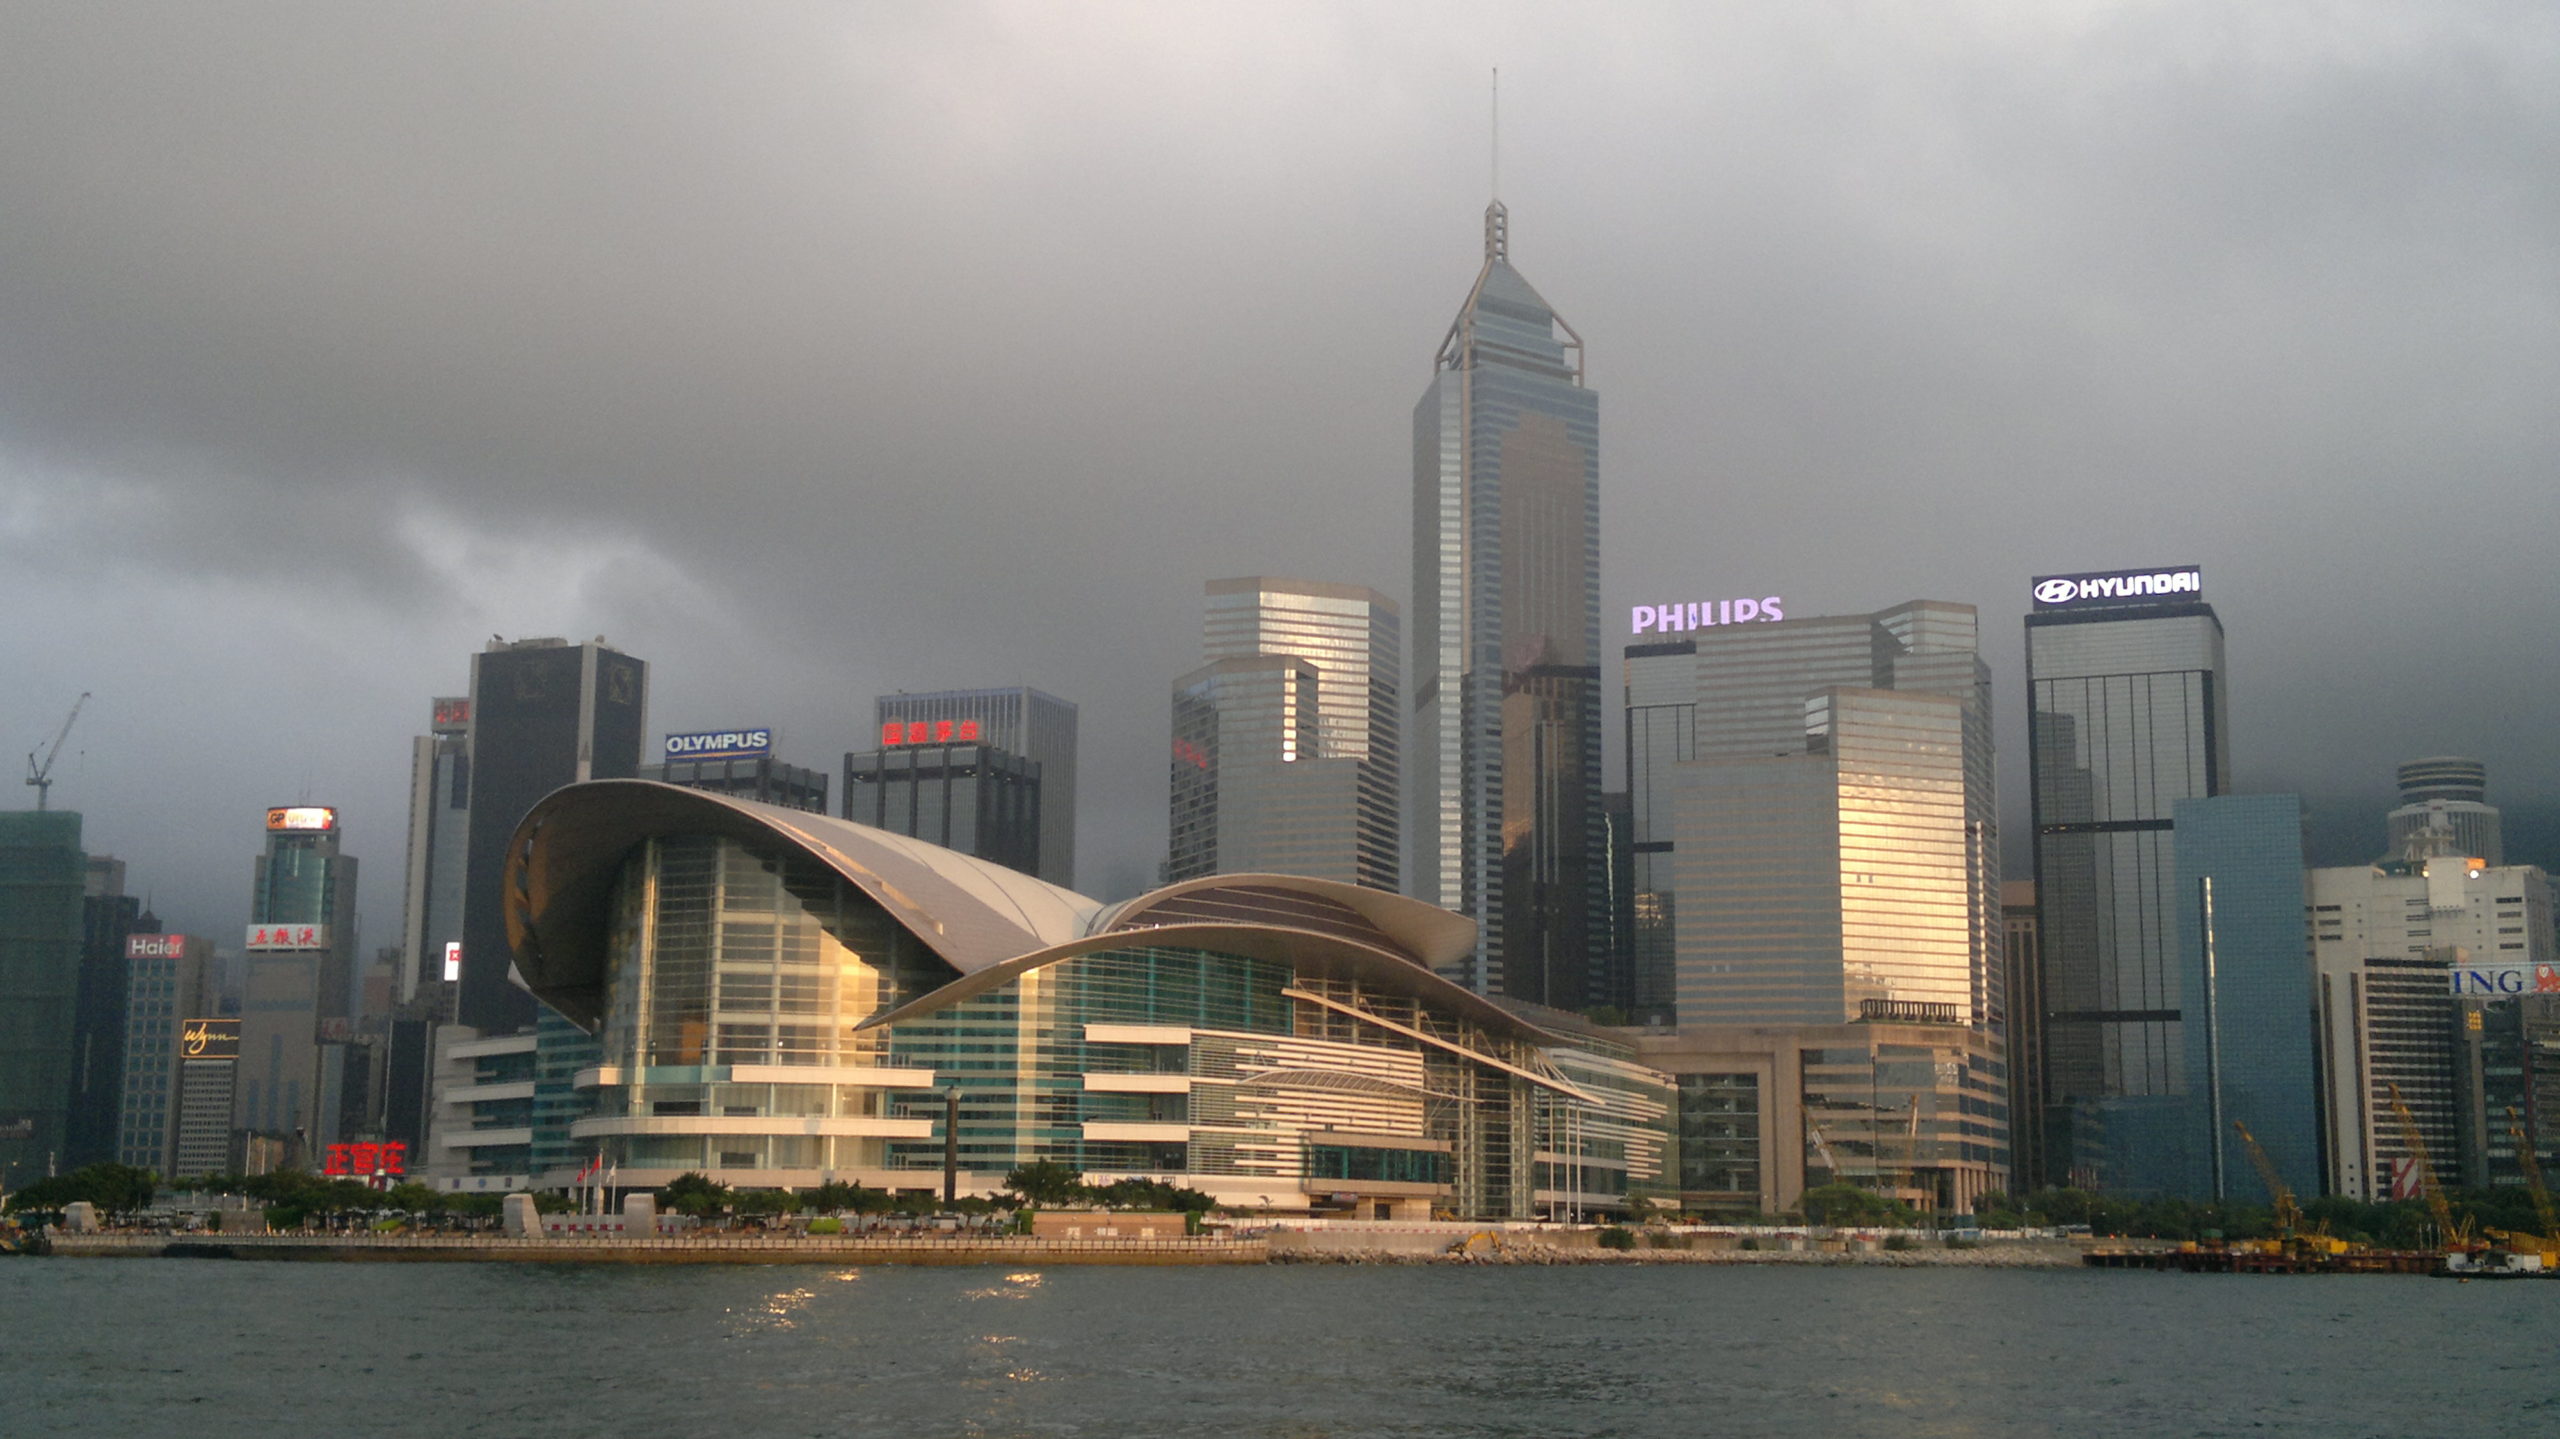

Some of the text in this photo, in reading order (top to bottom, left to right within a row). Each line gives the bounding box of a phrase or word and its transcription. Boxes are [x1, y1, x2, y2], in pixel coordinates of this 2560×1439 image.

[2079, 572, 2199, 599] HYUNDAI
[1631, 597, 1784, 634] PHILIPS
[666, 732, 768, 752] OLYMPUS
[132, 938, 182, 955] Haier
[2453, 970, 2522, 994] ING
[324, 1141, 406, 1175] 正官庄
